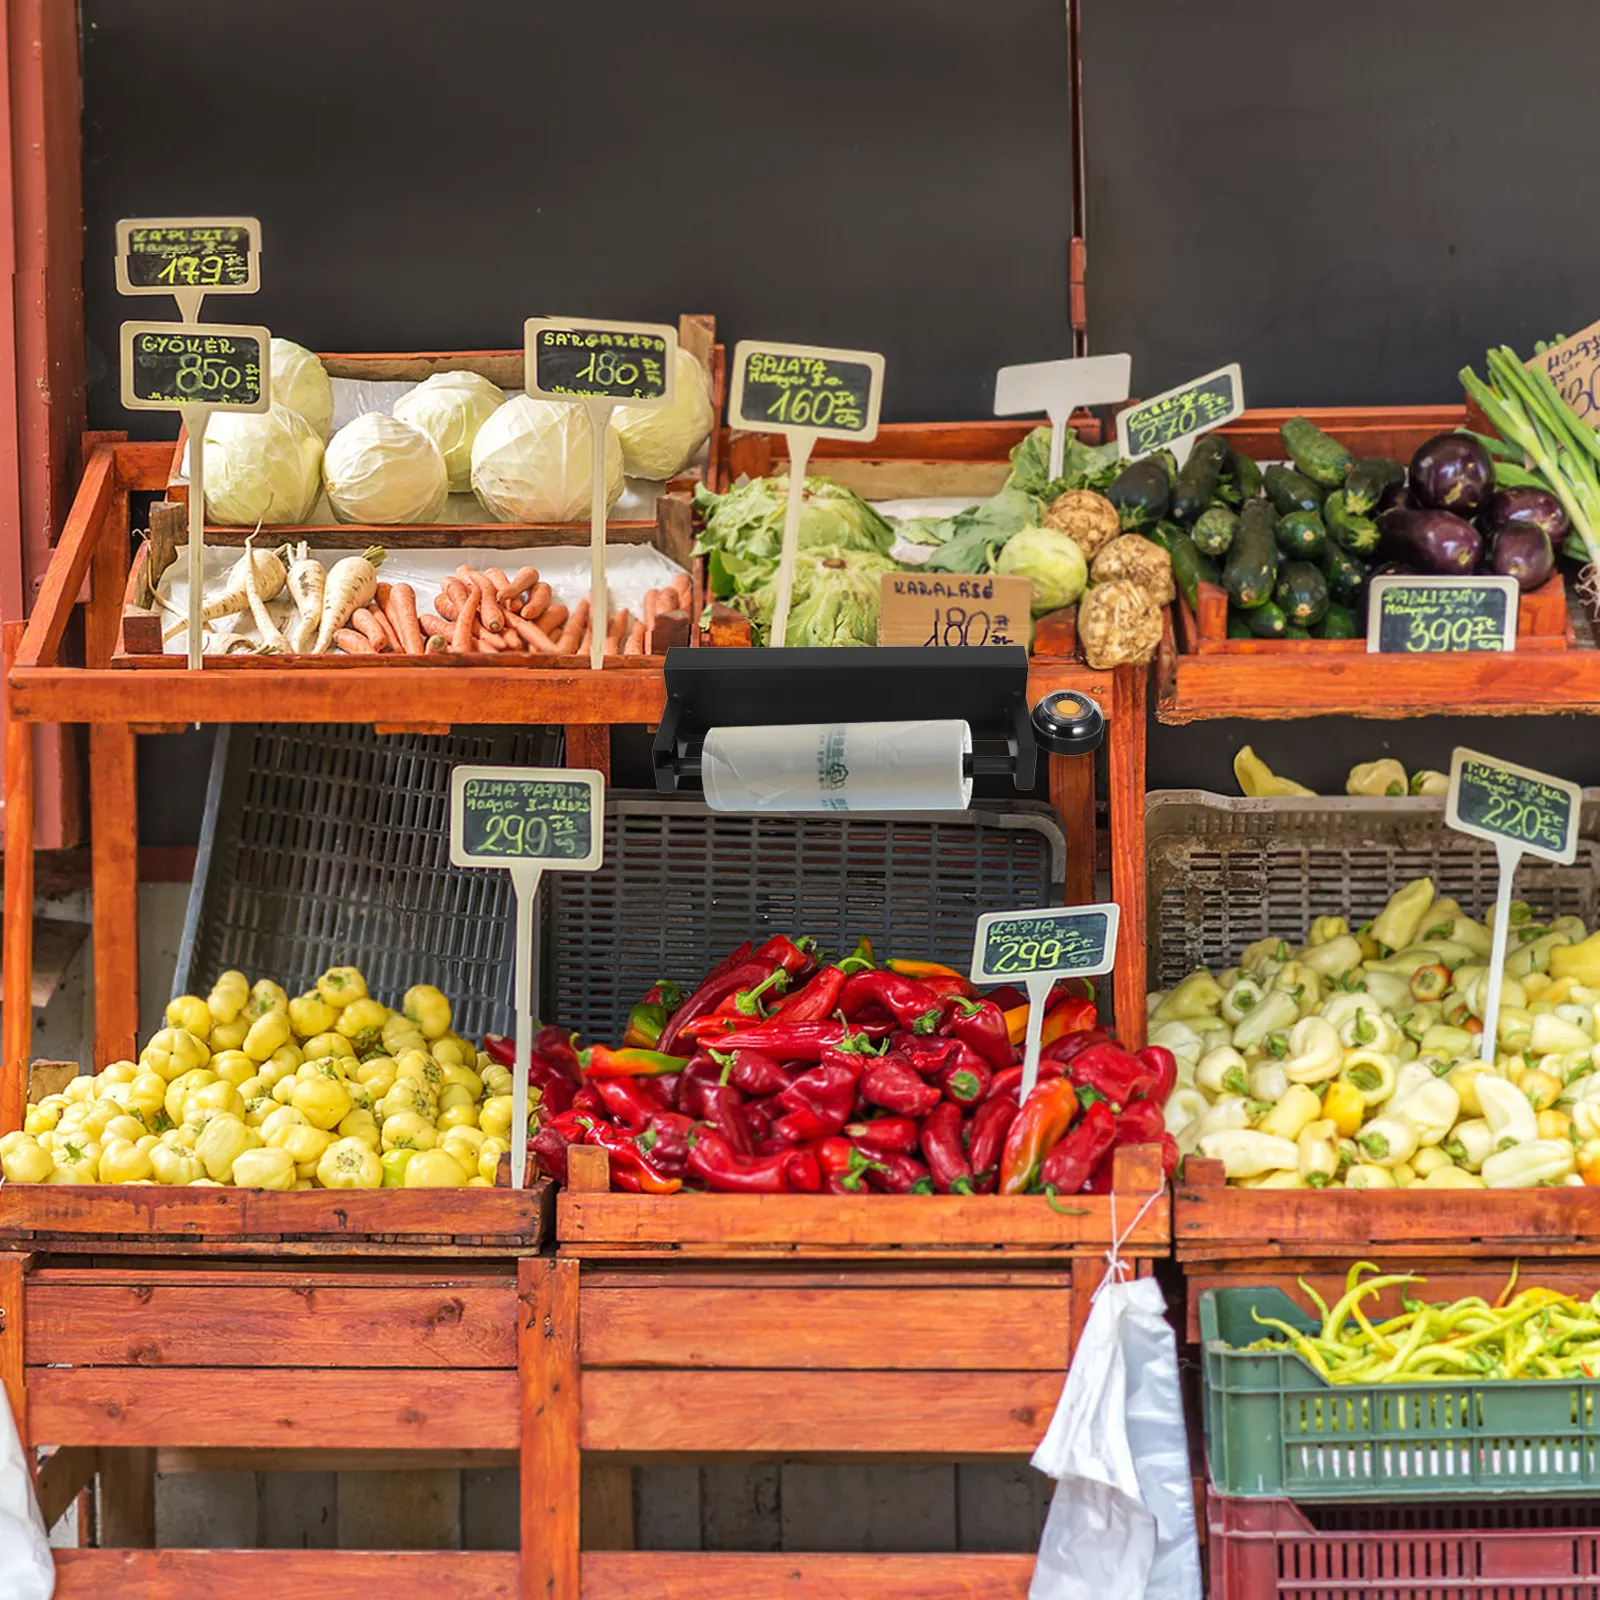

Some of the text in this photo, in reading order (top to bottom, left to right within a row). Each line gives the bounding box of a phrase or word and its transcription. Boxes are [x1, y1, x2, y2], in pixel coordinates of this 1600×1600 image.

[158, 255, 223, 286] 179
[176, 353, 241, 393] 850
[575, 351, 639, 386] 180
[767, 388, 834, 425] 160
[1138, 409, 1197, 453] 270
[923, 606, 990, 647] 180
[1405, 617, 1472, 652] 399
[466, 780, 517, 797] ALMA
[476, 814, 547, 856] 299
[1481, 795, 1541, 840] 220
[992, 939, 1061, 973] 299
